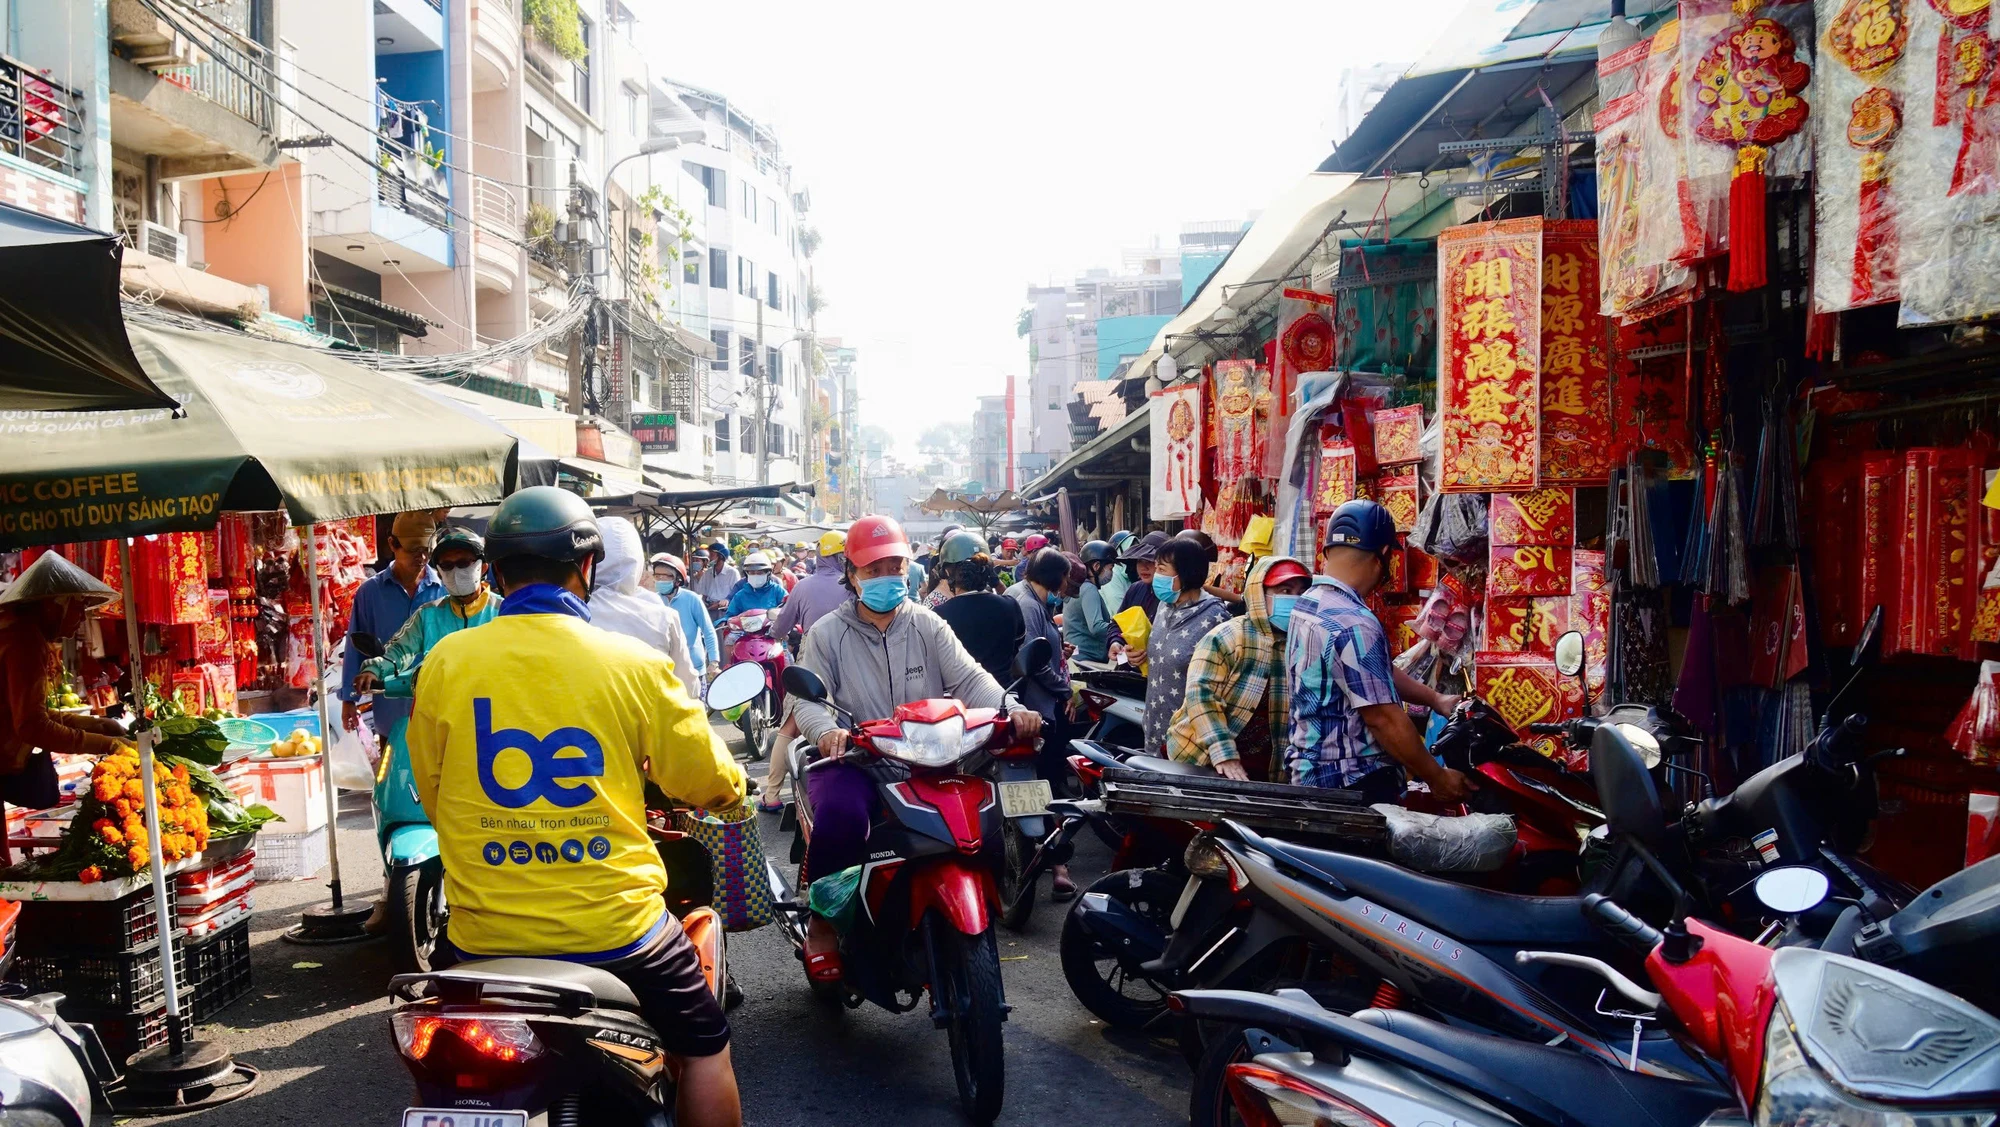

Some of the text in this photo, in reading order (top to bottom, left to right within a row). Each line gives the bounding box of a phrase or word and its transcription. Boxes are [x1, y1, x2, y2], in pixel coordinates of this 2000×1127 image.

[1461, 256, 1518, 425] 開張鴻發
[43, 419, 98, 434] QUÁN
[101, 416, 125, 428] CÀ
[130, 408, 166, 425] PHÊ
[631, 426, 675, 442] MINH TÂN
[34, 472, 139, 501] COFFEE
[286, 464, 497, 498] WWW.EMCCOFFEE.COM
[1322, 479, 1347, 507] 福
[19, 509, 58, 531] CHO
[60, 503, 84, 528] TƯ
[88, 503, 125, 526] DUY
[128, 496, 176, 522] SÁNG
[905, 665, 924, 675] Jeep
[473, 697, 605, 808] be
[1006, 783, 1045, 799] 92-H5
[480, 814, 610, 830] Bên nhau trọn đường
[870, 849, 896, 860] HONDA
[1361, 903, 1463, 961] SIRIUS
[454, 1098, 492, 1107] HONDA
